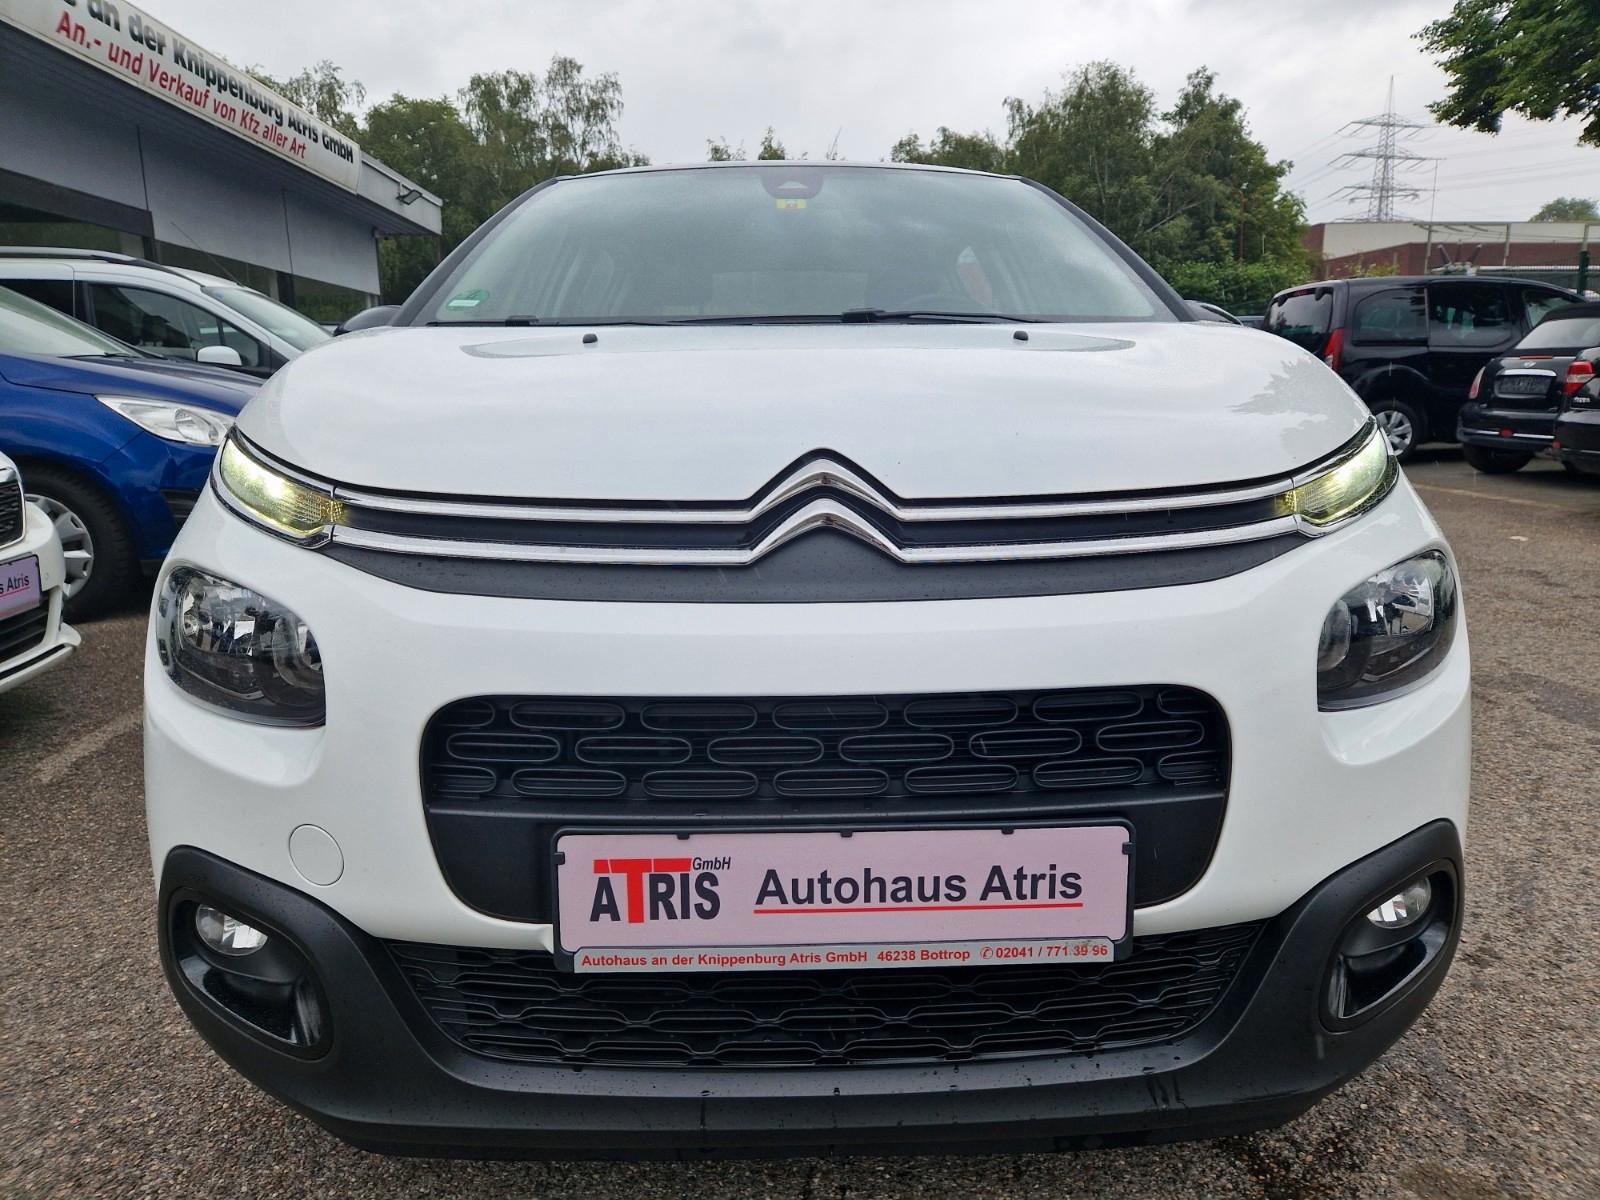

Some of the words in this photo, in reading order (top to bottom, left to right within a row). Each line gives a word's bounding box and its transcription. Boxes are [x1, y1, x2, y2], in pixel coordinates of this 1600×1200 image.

[108, 42, 143, 76] und
[149, 58, 210, 109] Verkauf
[213, 98, 237, 123] von
[240, 108, 260, 136] Kfz
[262, 124, 288, 149] aller
[289, 137, 307, 159] Art
[128, 14, 167, 56] der
[172, 38, 284, 127] Knippenburg
[322, 130, 354, 163] GmbH
[7, 573, 30, 592] Atris
[590, 858, 721, 923] ATRIS
[692, 856, 731, 872] GmbH
[755, 867, 967, 906] Autohaus
[979, 864, 1083, 902] Atris
[581, 954, 648, 967] Autohaus
[652, 955, 667, 966] an
[672, 953, 694, 966] der
[698, 953, 786, 968] Knippenburg
[790, 952, 822, 964] Atris
[825, 951, 868, 963] GmbH
[877, 950, 916, 962] 46238
[920, 949, 970, 962] Bottrop
[995, 946, 1033, 959] 02041
[1046, 945, 1068, 957] 771
[1092, 944, 1109, 956] 96
